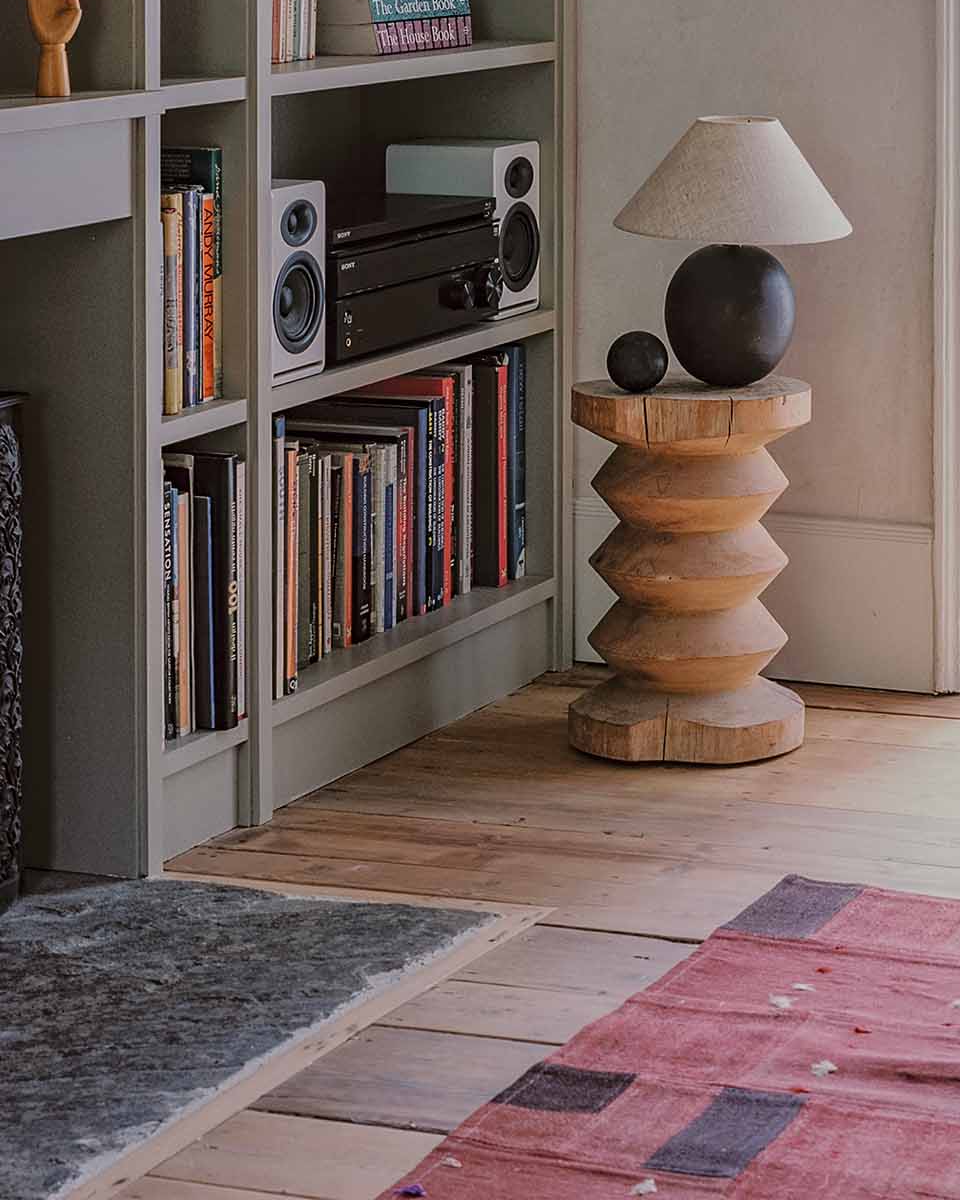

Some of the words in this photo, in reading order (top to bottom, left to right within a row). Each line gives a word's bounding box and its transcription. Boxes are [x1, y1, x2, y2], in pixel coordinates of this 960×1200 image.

[373, 0, 392, 16] The
[377, 30, 398, 47] The
[400, 28, 430, 44] House
[431, 22, 456, 42] Book
[203, 208, 214, 259] ANDY
[337, 231, 351, 240] SONY
[341, 262, 355, 271] SONY
[203, 263, 214, 342] MURRAY
[164, 503, 172, 581] SENSATION
[228, 580, 238, 616] 100
